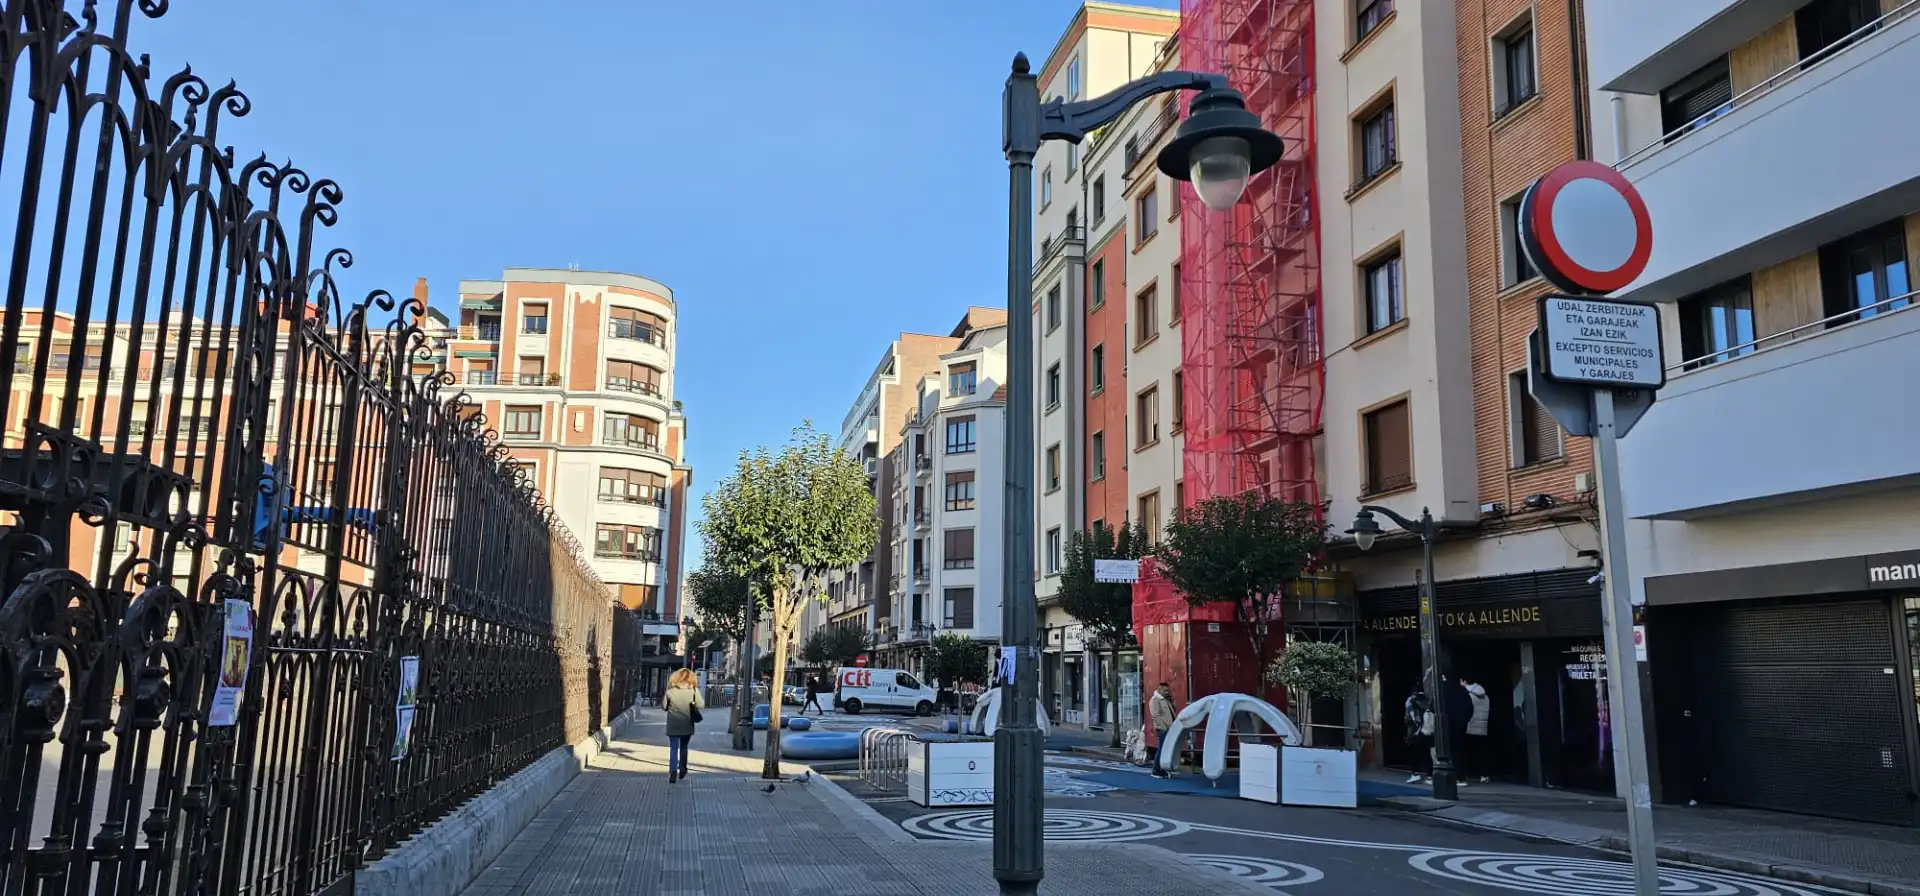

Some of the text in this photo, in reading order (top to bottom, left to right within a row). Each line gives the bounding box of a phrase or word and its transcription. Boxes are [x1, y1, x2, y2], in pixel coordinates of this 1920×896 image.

[1557, 301, 1646, 316] UDAL ZERBITZUAK
[1566, 314, 1639, 328] ETA GARAJEAK
[1580, 327, 1627, 339] IZAN EZIK
[1555, 341, 1654, 358] EXCEPTO SERVICIOS
[1574, 356, 1638, 369] MUNICIPALES
[1580, 368, 1635, 380] Y GARAJES
[1480, 606, 1541, 624] ALLENDE
[1372, 615, 1418, 630] ALLENDE
[1571, 671, 1597, 680] RULETA
